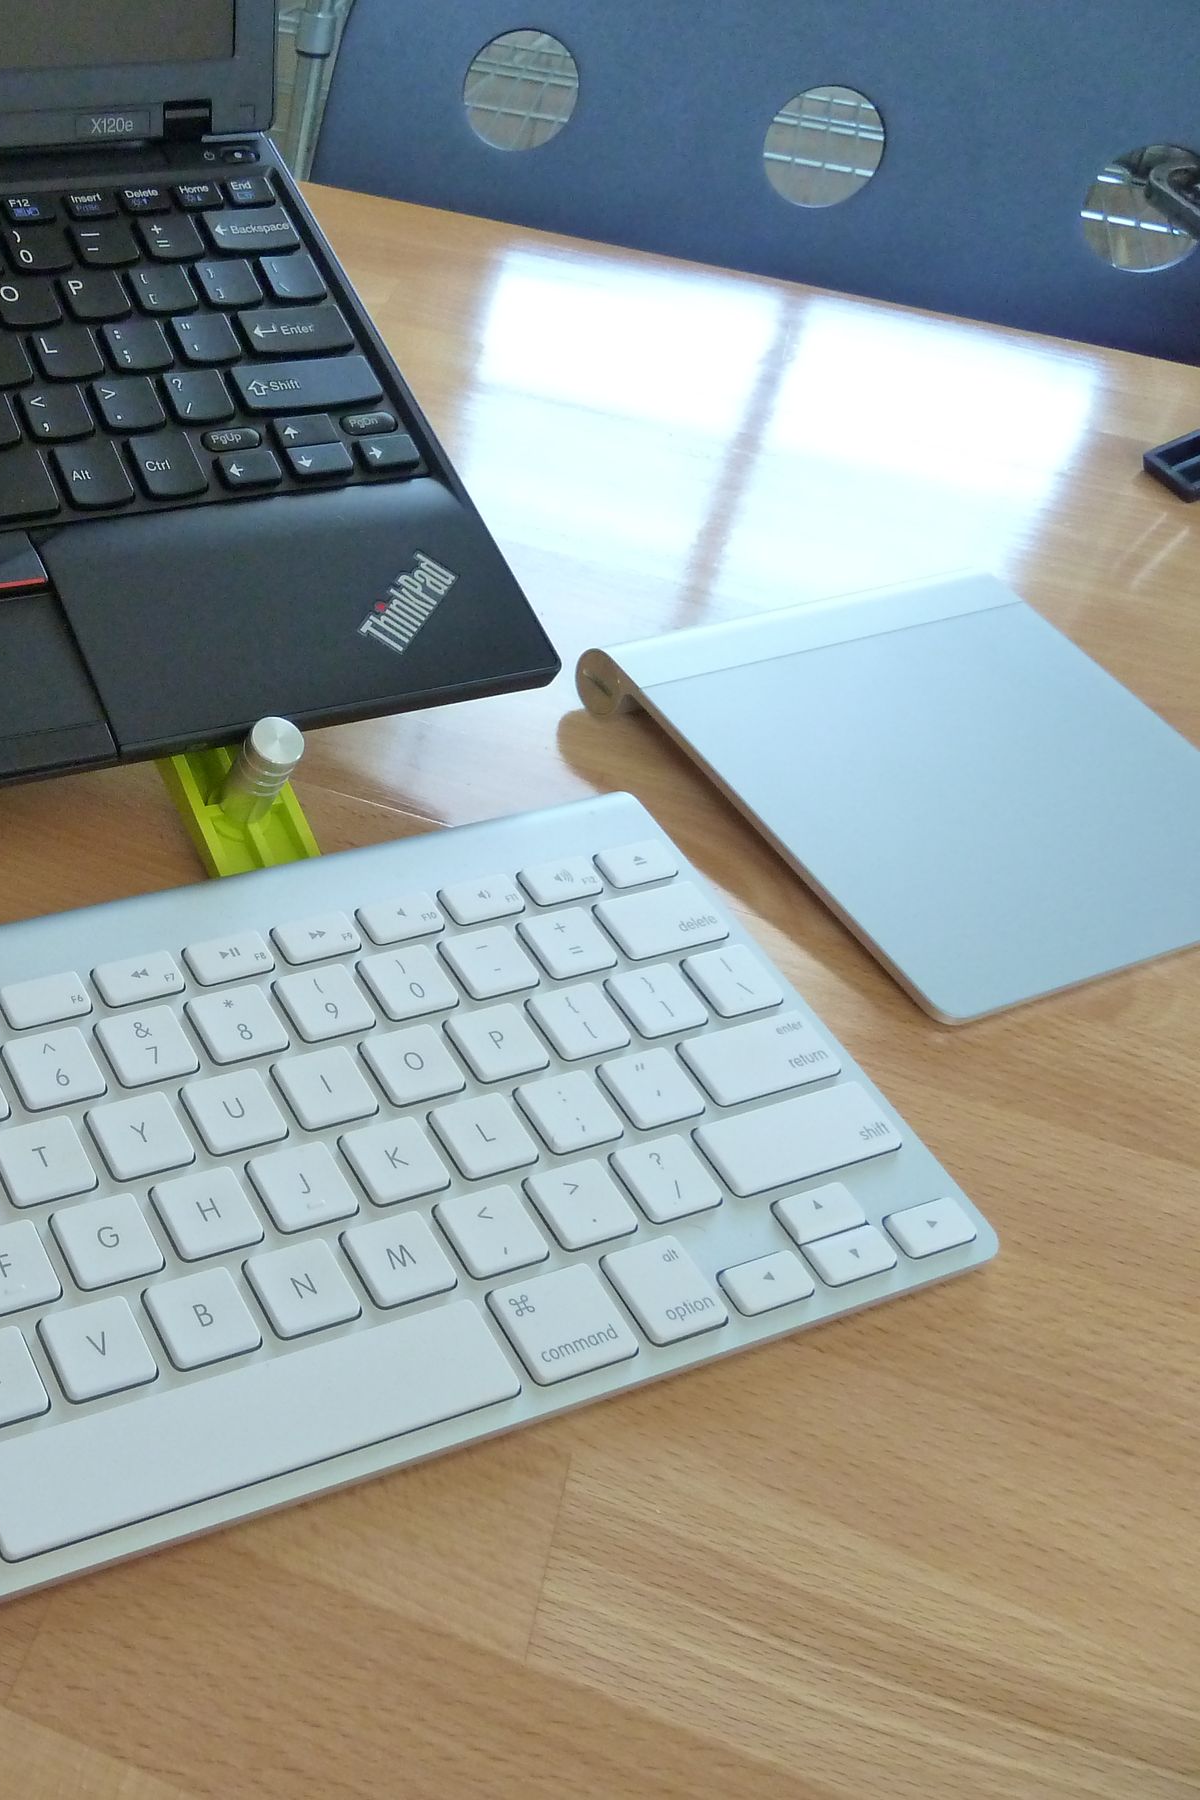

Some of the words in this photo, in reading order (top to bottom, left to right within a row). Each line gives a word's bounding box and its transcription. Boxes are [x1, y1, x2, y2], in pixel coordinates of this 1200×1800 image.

[92, 118, 133, 133] X120e
[231, 181, 251, 190] End
[71, 194, 101, 203] Insert
[125, 190, 158, 198] Delete
[9, 199, 30, 207] F12
[230, 223, 289, 234] Backspace
[20, 250, 32, 263] 0
[0, 286, 18, 301] O
[68, 281, 82, 295] P
[281, 325, 312, 334] Enter
[40, 338, 57, 353] L
[172, 378, 183, 391] ?
[270, 380, 299, 390] Shift
[350, 417, 378, 429] PgDn
[211, 433, 241, 444] PgUp
[146, 460, 170, 471] Ctrl
[73, 470, 91, 480] Alt
[360, 554, 455, 651] ThinkPad
[421, 912, 436, 920] F10
[679, 916, 717, 932] delete
[254, 952, 266, 960] F8
[164, 973, 174, 982] F7
[71, 995, 83, 1003] F6
[325, 1003, 338, 1019] 9
[134, 1022, 152, 1038] &
[237, 1024, 253, 1040] 8
[776, 1022, 802, 1034] enter
[488, 1031, 503, 1049] P
[146, 1046, 157, 1064] 7
[788, 1050, 828, 1068] return
[56, 1069, 69, 1086] 6
[223, 1098, 244, 1118] U
[130, 1122, 147, 1142] Y
[476, 1124, 496, 1142] L
[859, 1122, 889, 1140] shift
[32, 1146, 48, 1167] T
[385, 1147, 408, 1168] K
[649, 1152, 664, 1170] ?
[300, 1173, 310, 1194] J
[196, 1198, 221, 1221] H
[97, 1227, 119, 1248] G
[386, 1245, 416, 1270] M
[663, 1250, 678, 1262] alt
[290, 1274, 317, 1299] N
[193, 1304, 213, 1327] B
[666, 1297, 715, 1320] option
[86, 1332, 105, 1355] V
[541, 1324, 618, 1362] command
